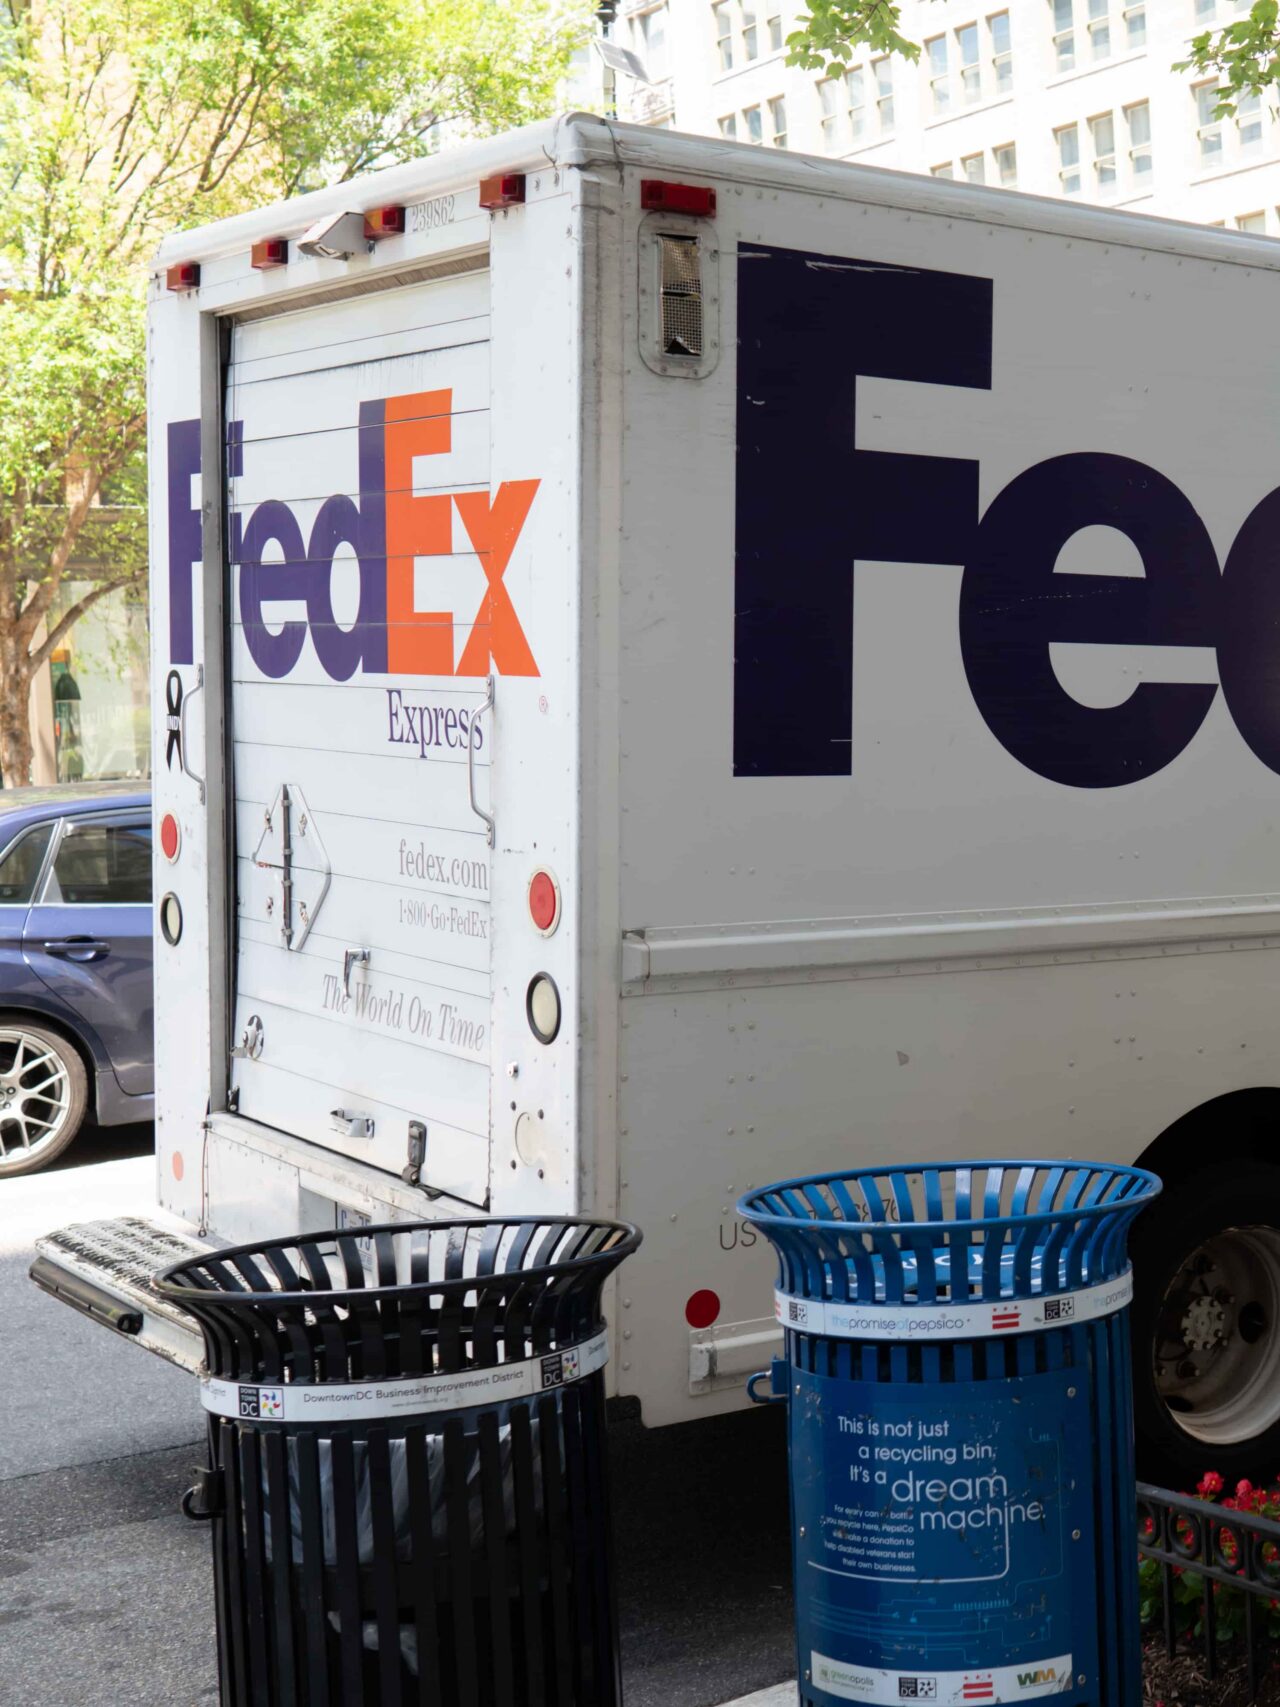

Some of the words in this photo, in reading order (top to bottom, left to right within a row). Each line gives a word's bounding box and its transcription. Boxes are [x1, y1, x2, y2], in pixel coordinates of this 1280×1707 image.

[412, 195, 455, 232] 239862
[167, 387, 542, 681] FedEx
[386, 689, 484, 759] Express
[399, 838, 488, 890] fedex.com
[322, 973, 350, 1014] The
[355, 981, 404, 1030] World
[408, 995, 432, 1037] On
[438, 1003, 485, 1051] Time
[719, 1222, 757, 1251] US
[1046, 1309, 1059, 1319] DC
[303, 1389, 372, 1403] DowntownDC
[376, 1387, 421, 1400] Business
[423, 1376, 489, 1396] Improvement
[492, 1369, 524, 1383] District
[544, 1370, 562, 1386] DC
[241, 1402, 258, 1416] DC
[838, 1415, 864, 1434] This
[868, 1419, 880, 1436] is
[884, 1421, 913, 1437] not
[918, 1420, 950, 1440] just
[858, 1446, 870, 1459] a
[874, 1445, 957, 1465] recycling
[850, 1465, 870, 1483] It's
[875, 1470, 887, 1484] a
[891, 1470, 1007, 1502] dream
[864, 1510, 879, 1518] can
[869, 1535, 905, 1546] donation
[906, 1538, 915, 1546] to
[837, 1543, 865, 1555] disabled
[866, 1549, 896, 1559] veterans
[897, 1550, 915, 1559] start
[858, 1561, 873, 1569] own
[1017, 1667, 1057, 1686] WM
[901, 1687, 916, 1696] DC
